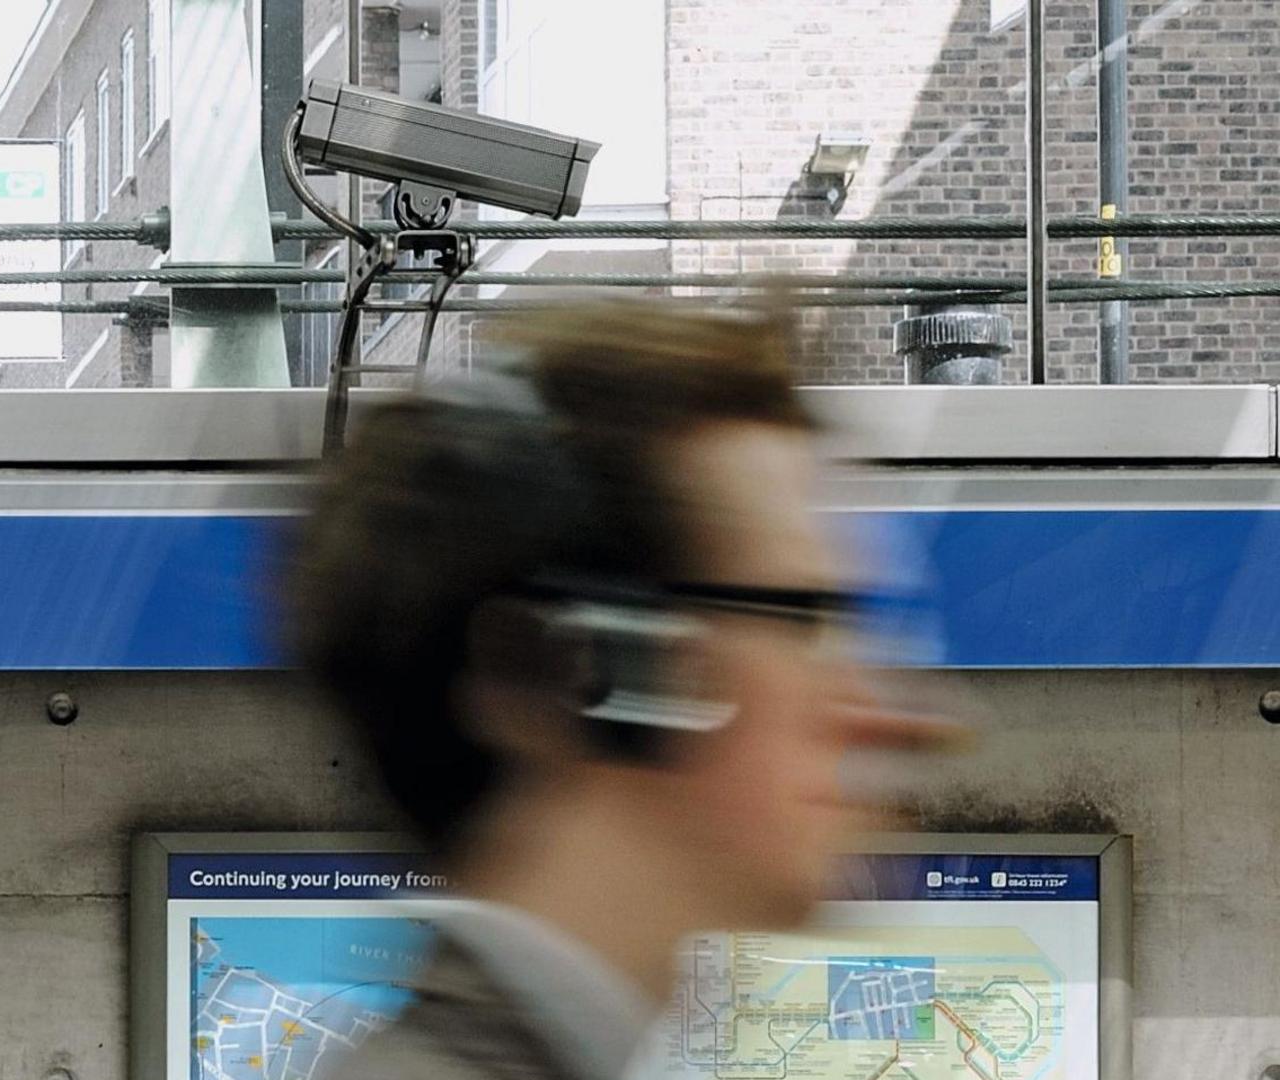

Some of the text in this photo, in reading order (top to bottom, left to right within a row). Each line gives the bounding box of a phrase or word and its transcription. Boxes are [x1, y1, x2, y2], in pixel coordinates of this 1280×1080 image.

[190, 870, 448, 890] Continuing your journey from
